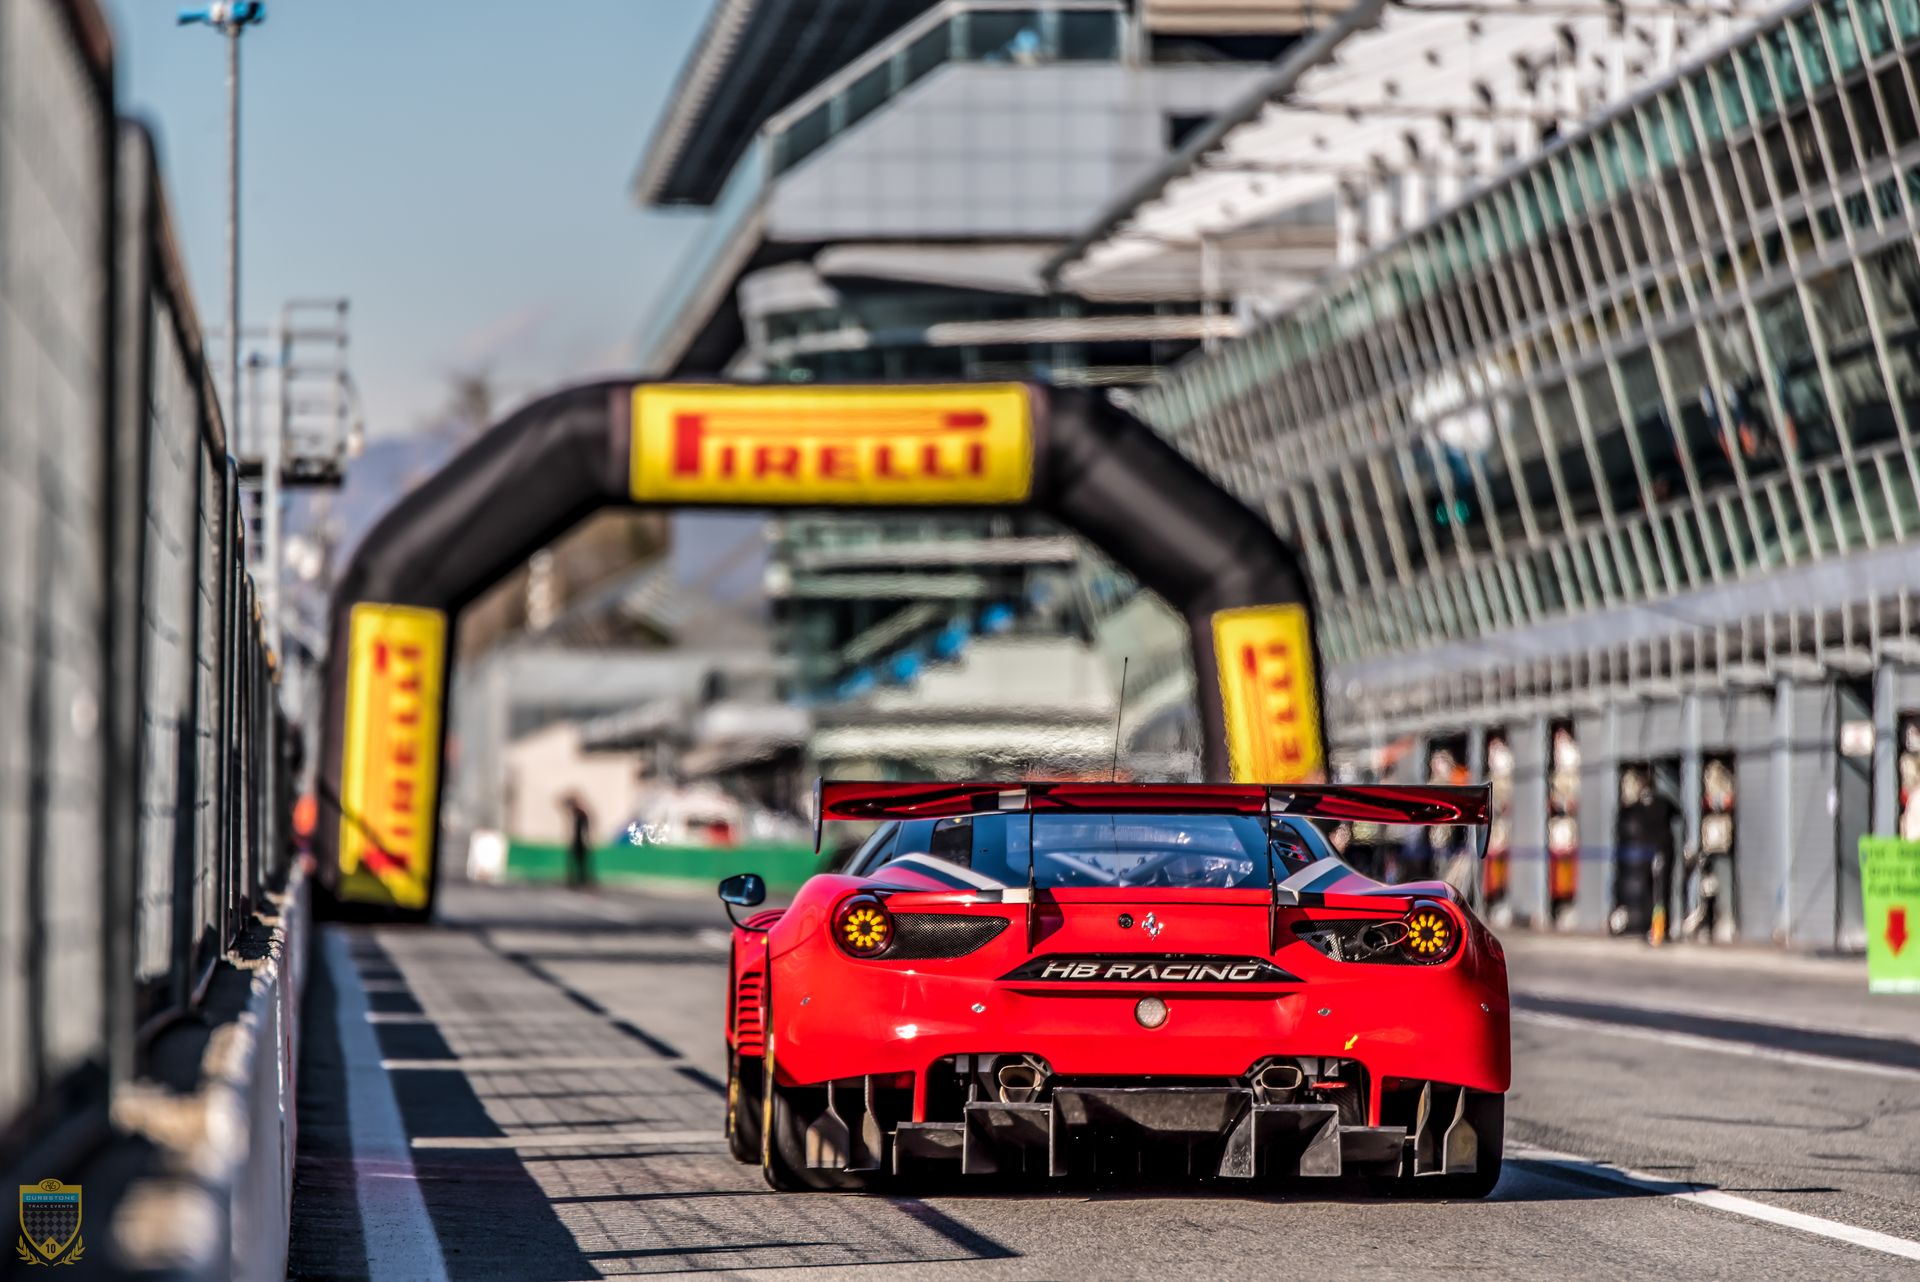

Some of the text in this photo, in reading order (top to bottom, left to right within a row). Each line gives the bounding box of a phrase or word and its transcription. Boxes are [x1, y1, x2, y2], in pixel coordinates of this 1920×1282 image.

[671, 409, 989, 478] PIRELLI
[1039, 961, 1262, 980] HB RACING
